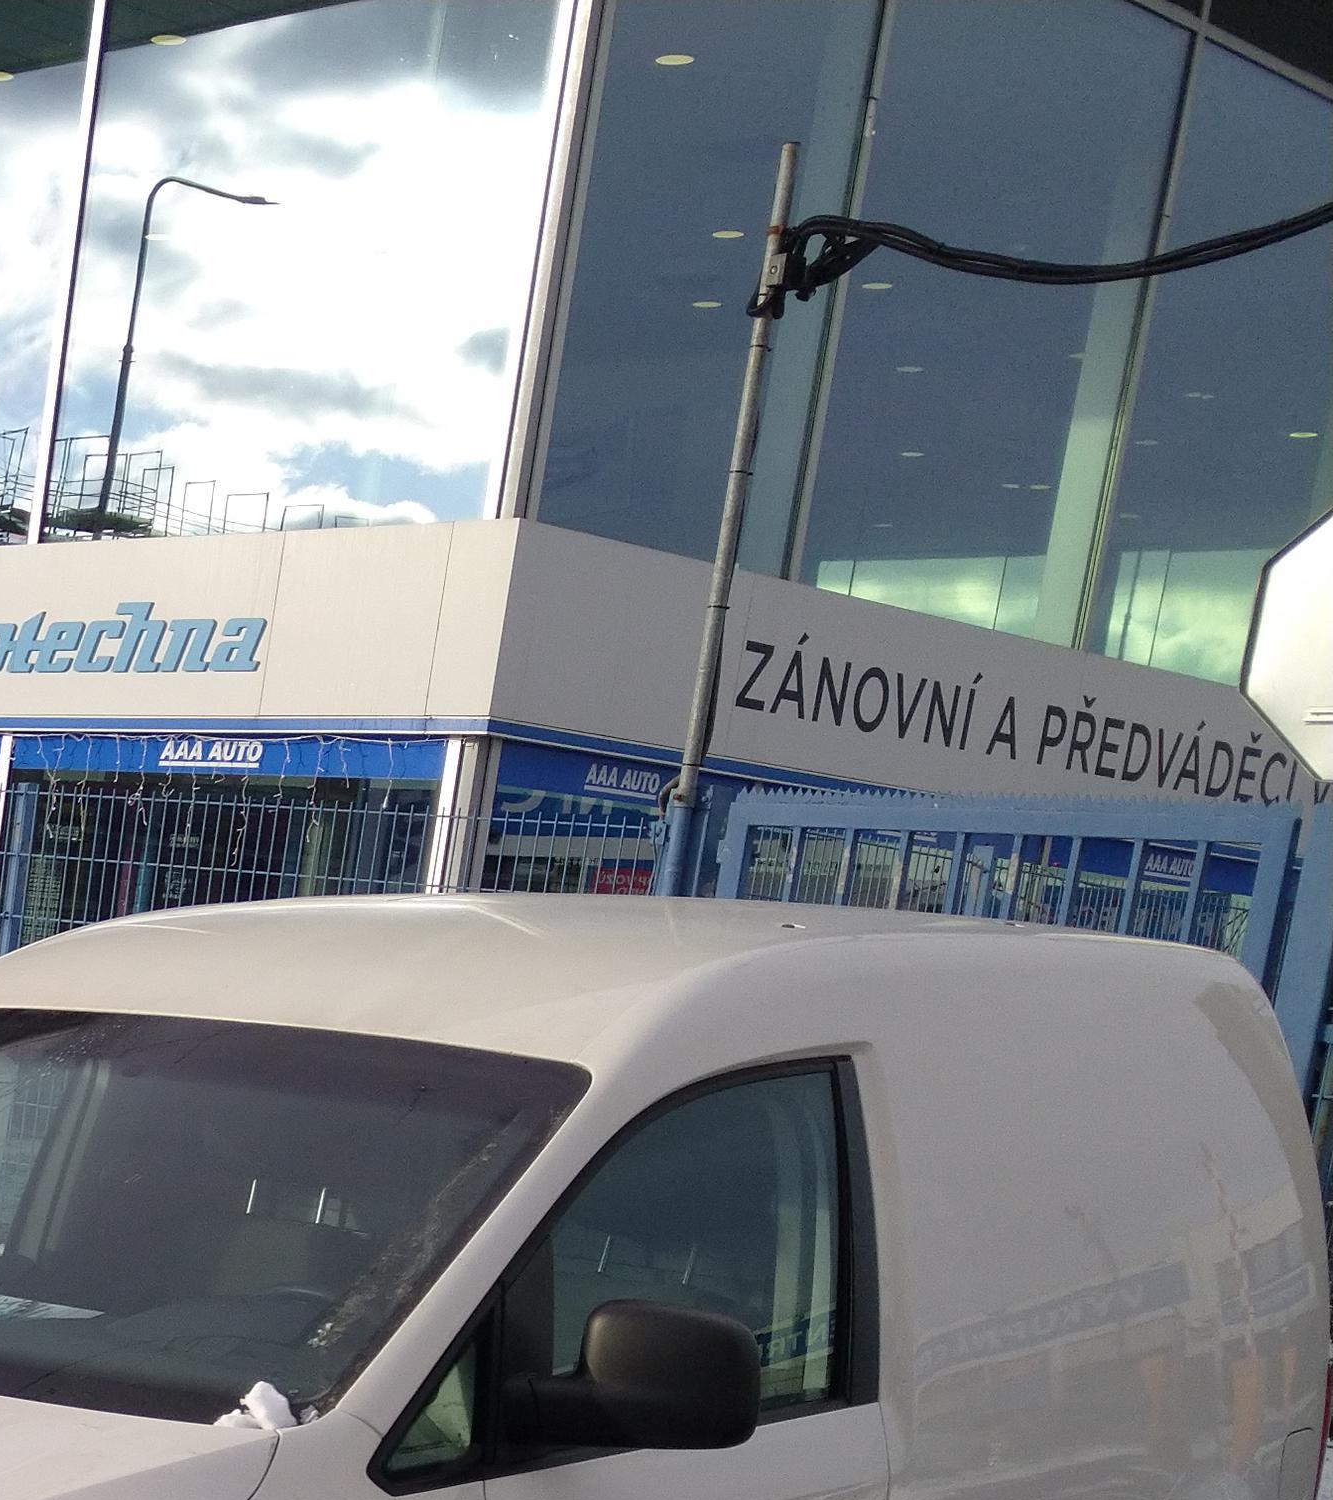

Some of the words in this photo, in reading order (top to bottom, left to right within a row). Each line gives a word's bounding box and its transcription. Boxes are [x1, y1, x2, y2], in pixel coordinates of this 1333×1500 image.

[735, 632, 983, 750] ZÁNOVNÍ
[986, 696, 1016, 760] A
[159, 740, 203, 761] AAA
[208, 741, 263, 762] AUTO
[585, 763, 618, 787] AAA
[621, 768, 661, 793] AUTO
[1144, 853, 1169, 873] AAA
